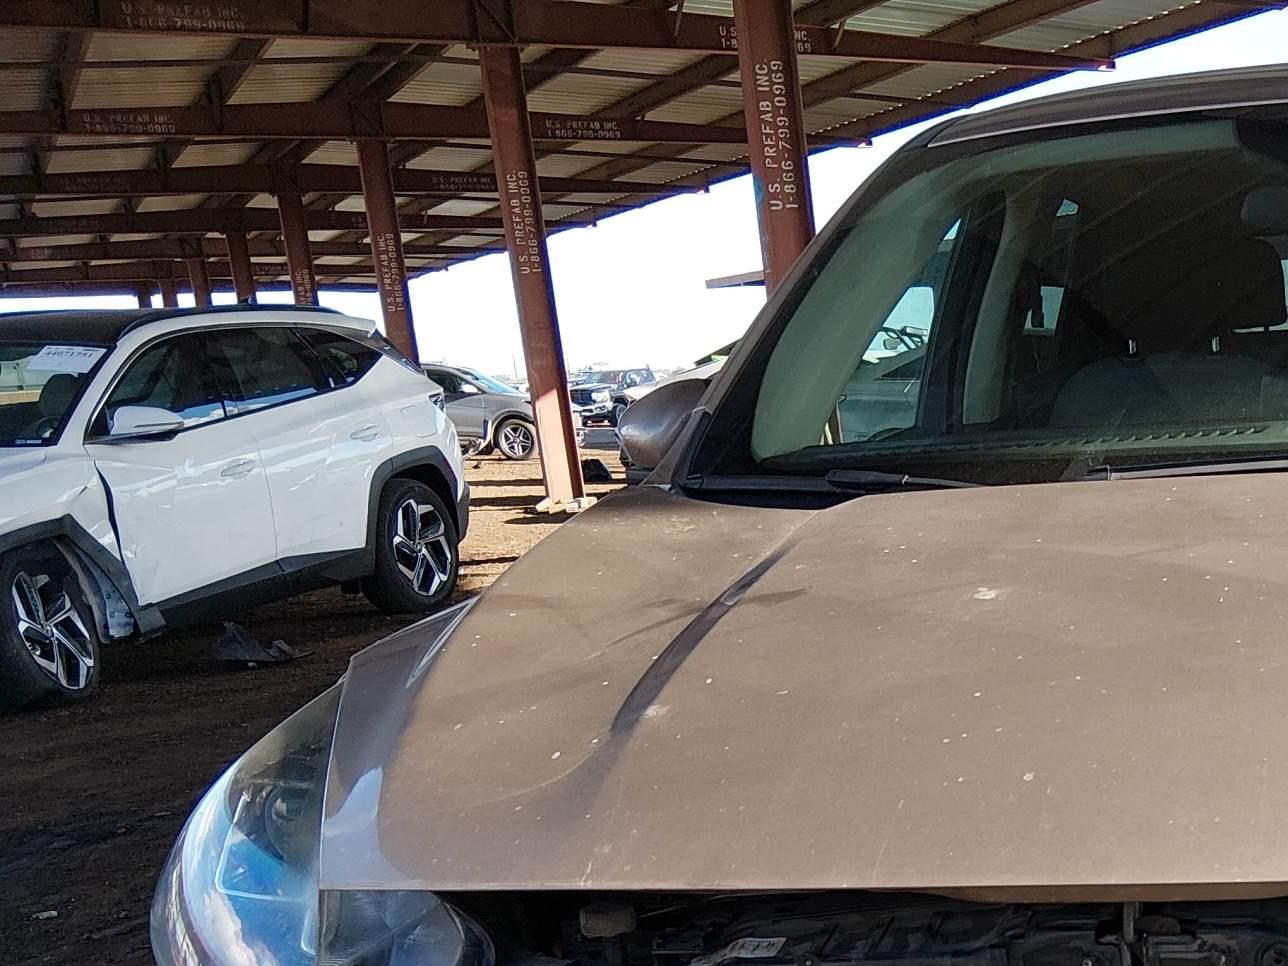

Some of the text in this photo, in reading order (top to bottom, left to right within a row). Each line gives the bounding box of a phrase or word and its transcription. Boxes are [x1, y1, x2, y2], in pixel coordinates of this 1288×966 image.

[755, 58, 784, 210] U.S. PREFAB INC.
[770, 60, 799, 209] 1-866-799-0969
[506, 170, 531, 274] U.S. PREFAB INC.
